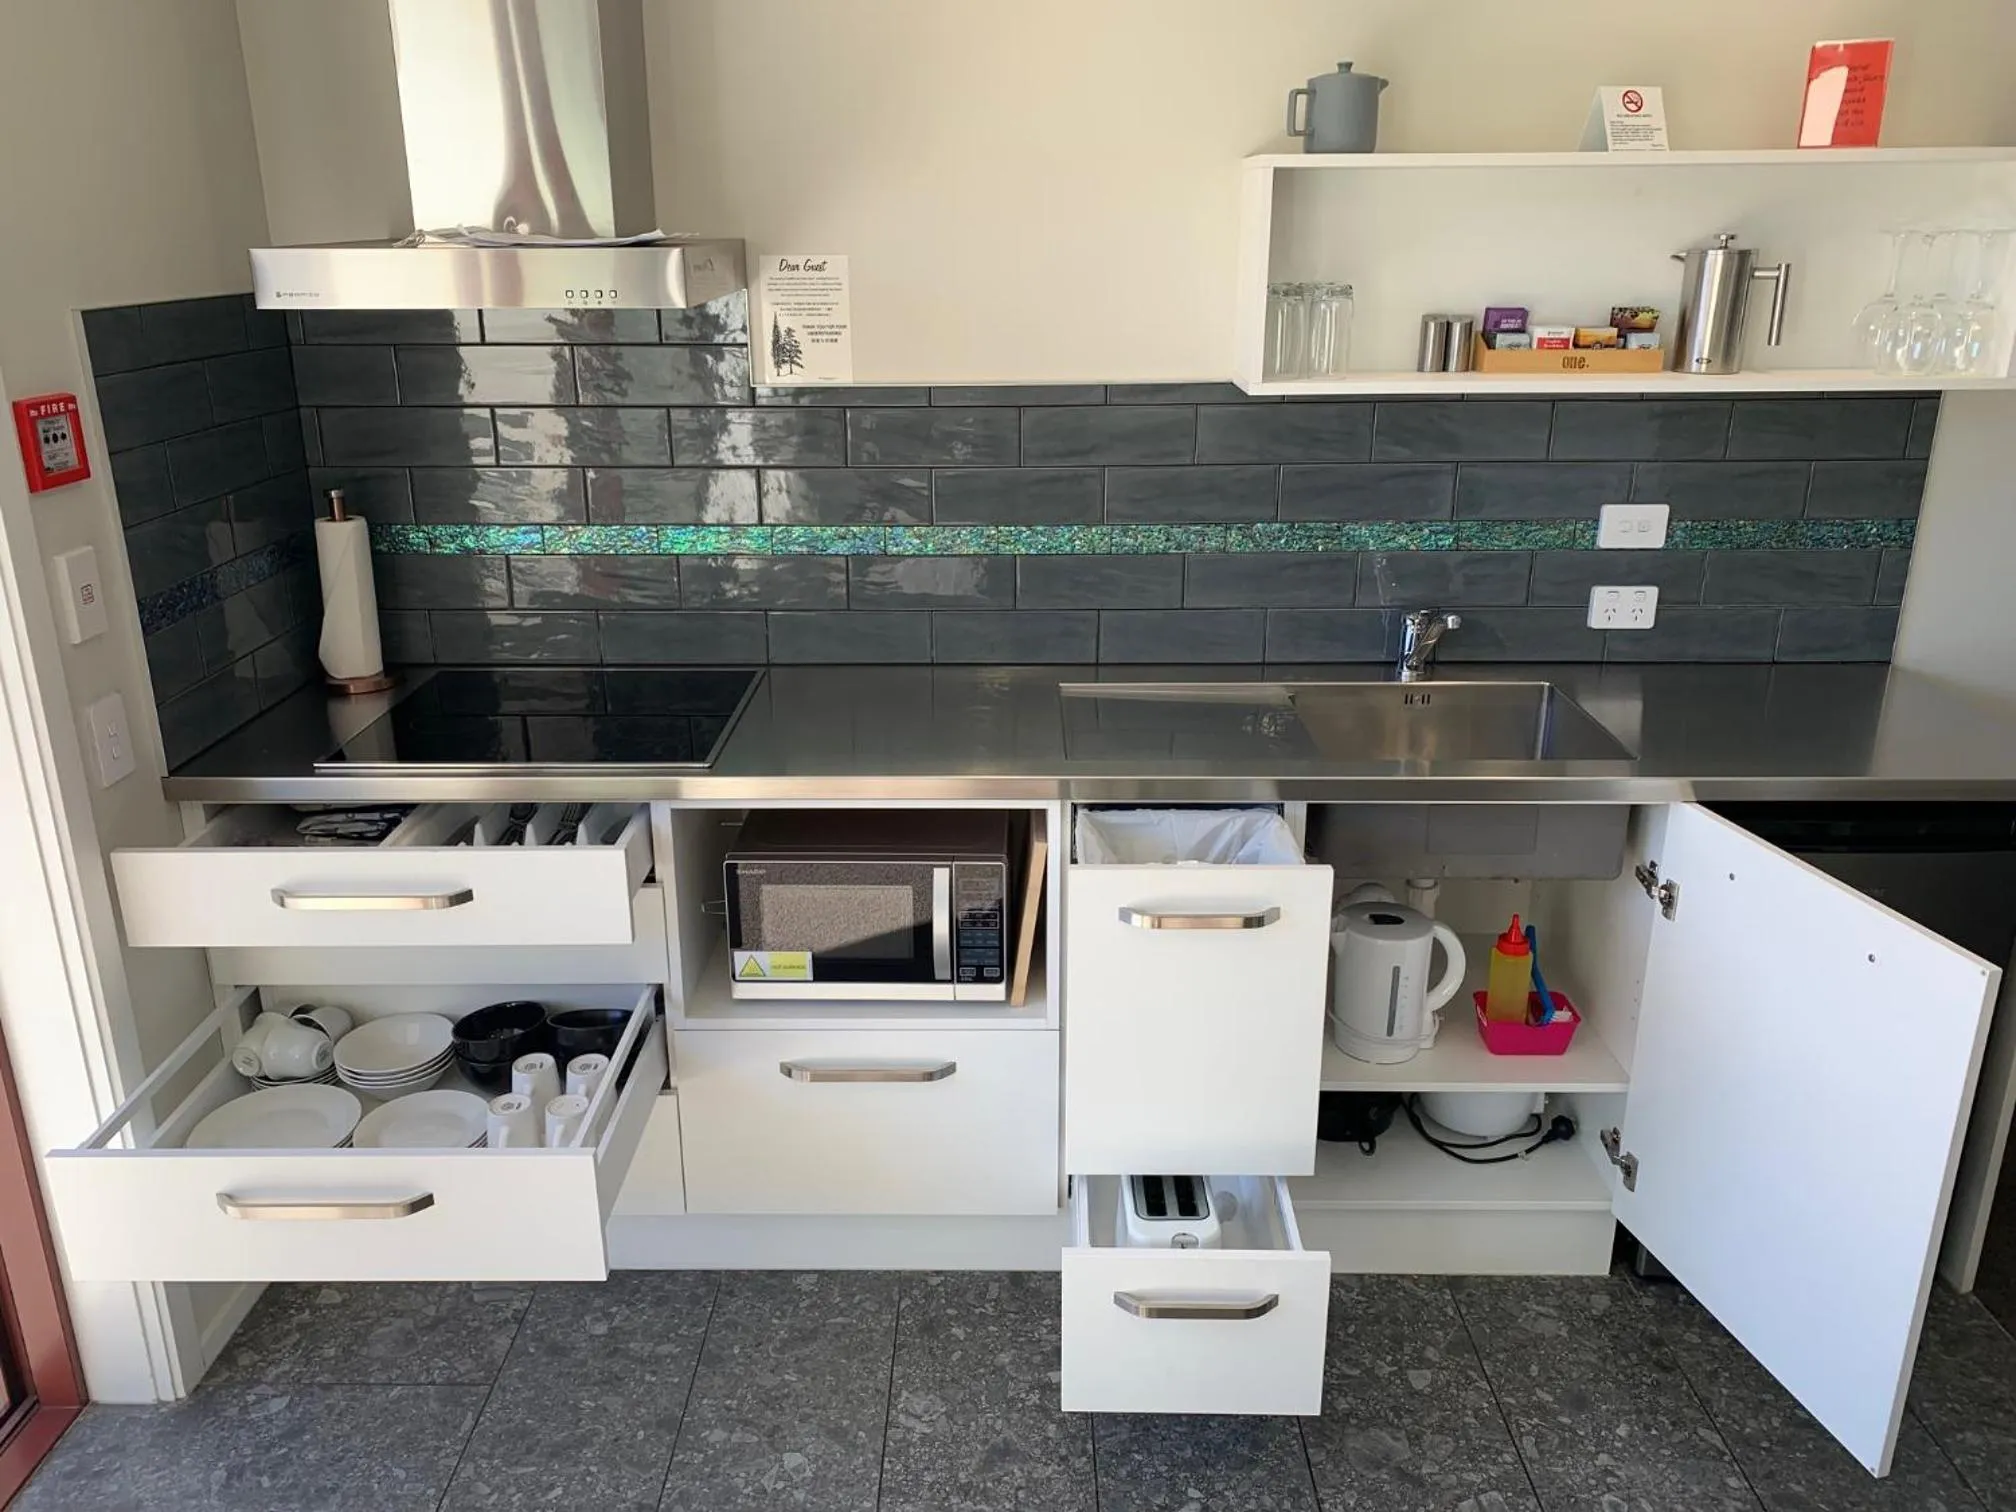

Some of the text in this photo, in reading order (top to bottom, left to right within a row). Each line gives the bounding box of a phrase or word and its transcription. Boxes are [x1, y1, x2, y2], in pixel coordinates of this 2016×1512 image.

[779, 258, 829, 272] Dear Guest
[1562, 356, 1589, 369] one.
[40, 402, 65, 416] FIRE
